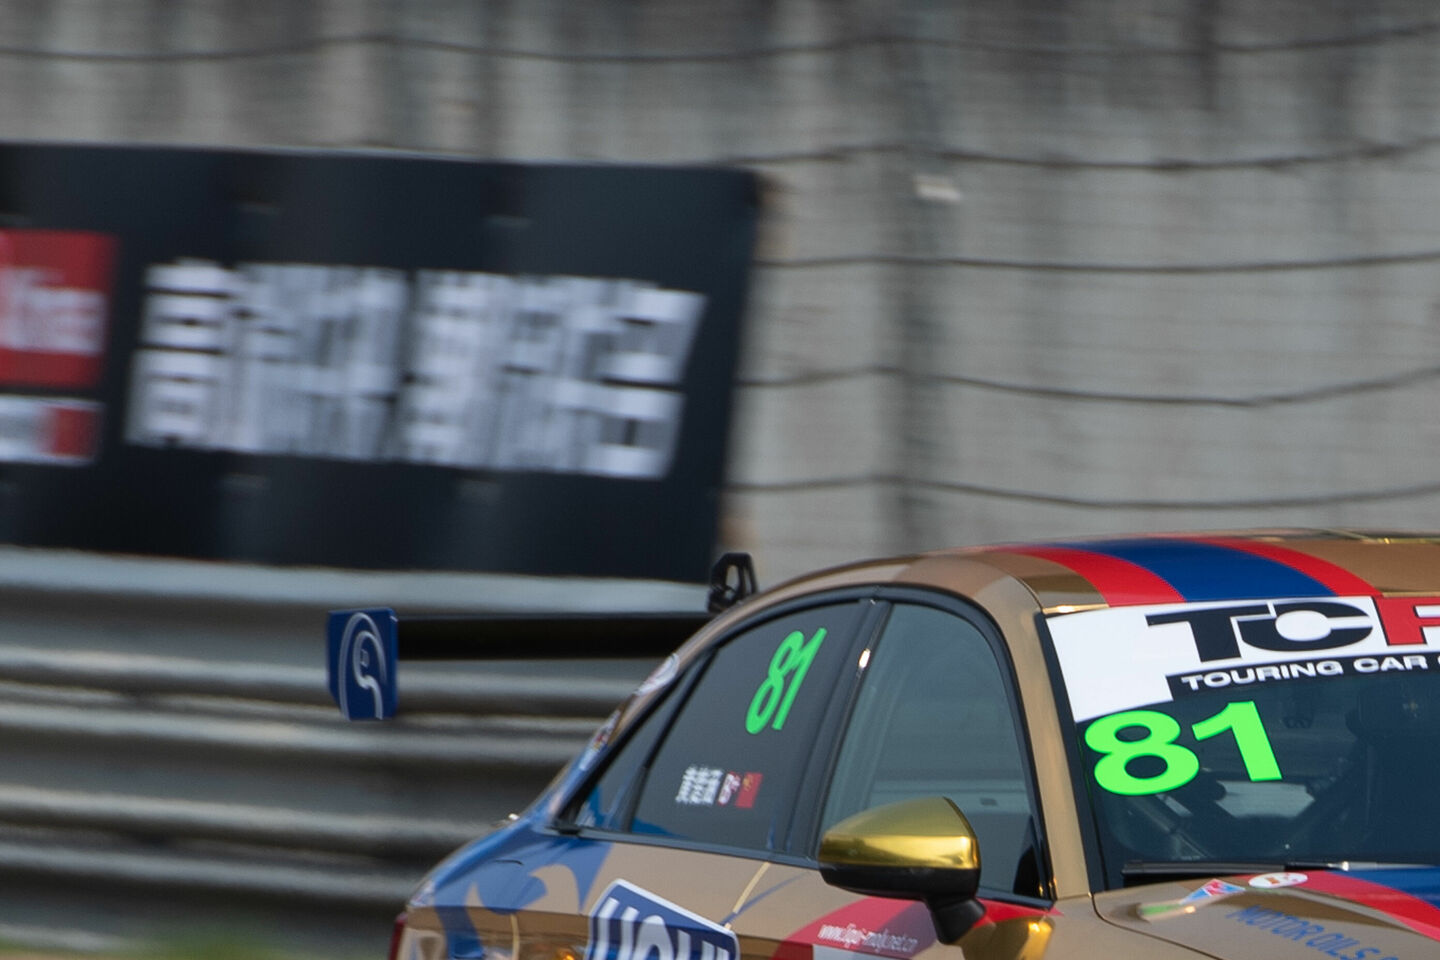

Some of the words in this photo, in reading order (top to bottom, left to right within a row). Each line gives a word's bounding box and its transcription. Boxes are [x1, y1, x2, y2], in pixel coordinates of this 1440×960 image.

[745, 627, 827, 734] 81
[1181, 659, 1343, 691] TOURING
[1353, 655, 1428, 673] CAR
[1082, 700, 1282, 795] 81
[1226, 905, 1324, 941] MOTOR
